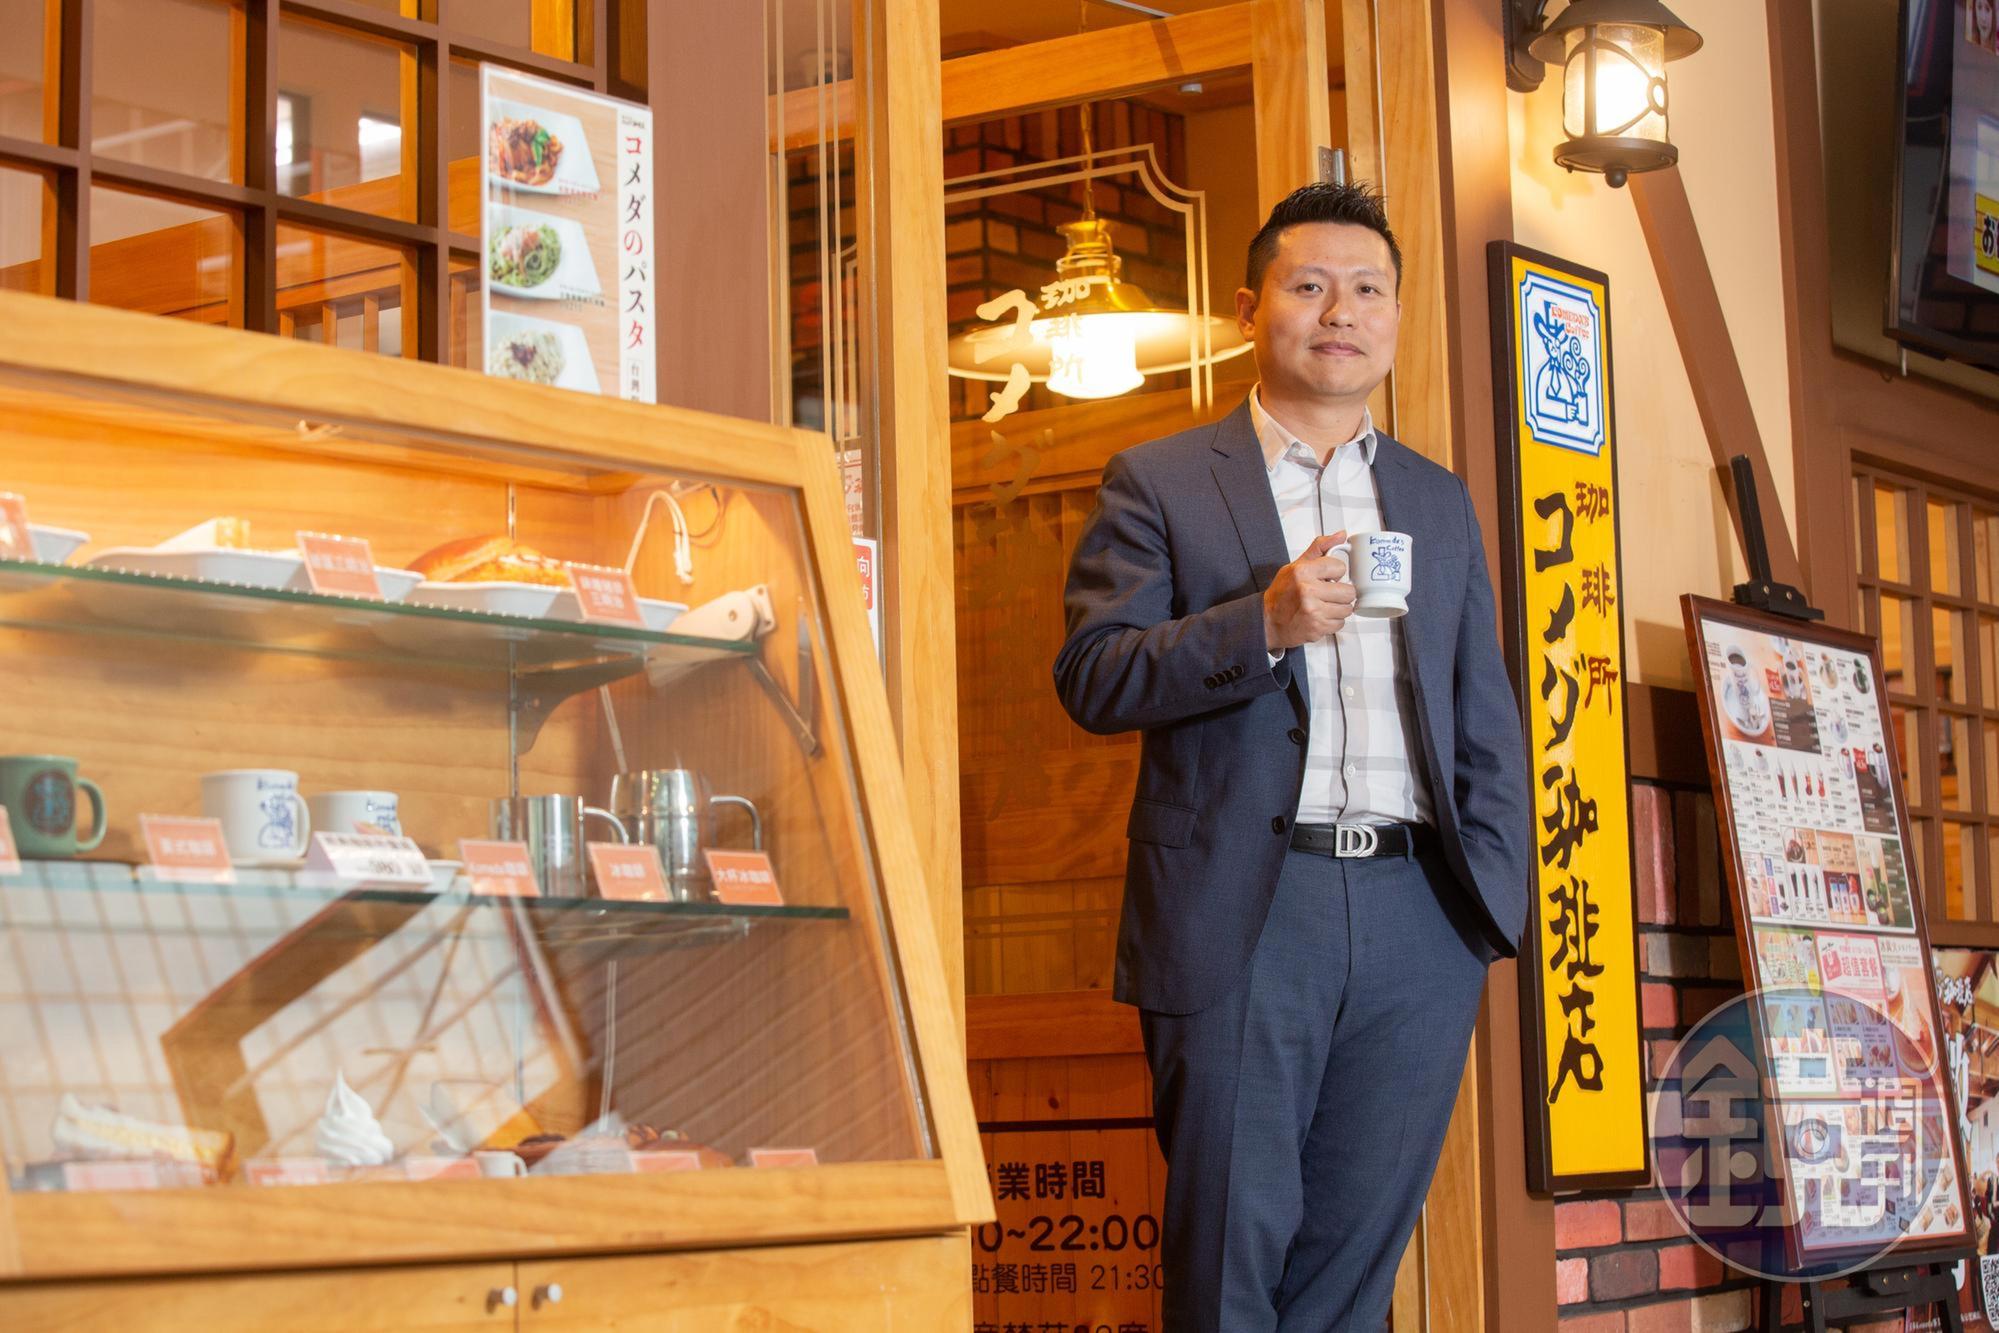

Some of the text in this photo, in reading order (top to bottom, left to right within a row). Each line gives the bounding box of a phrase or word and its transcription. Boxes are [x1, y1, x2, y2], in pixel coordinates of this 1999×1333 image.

[624, 134, 647, 350] コメダのパスタ
[1575, 481, 1619, 716] 珈琲所
[1533, 491, 1606, 1105] コメダ珈琲店
